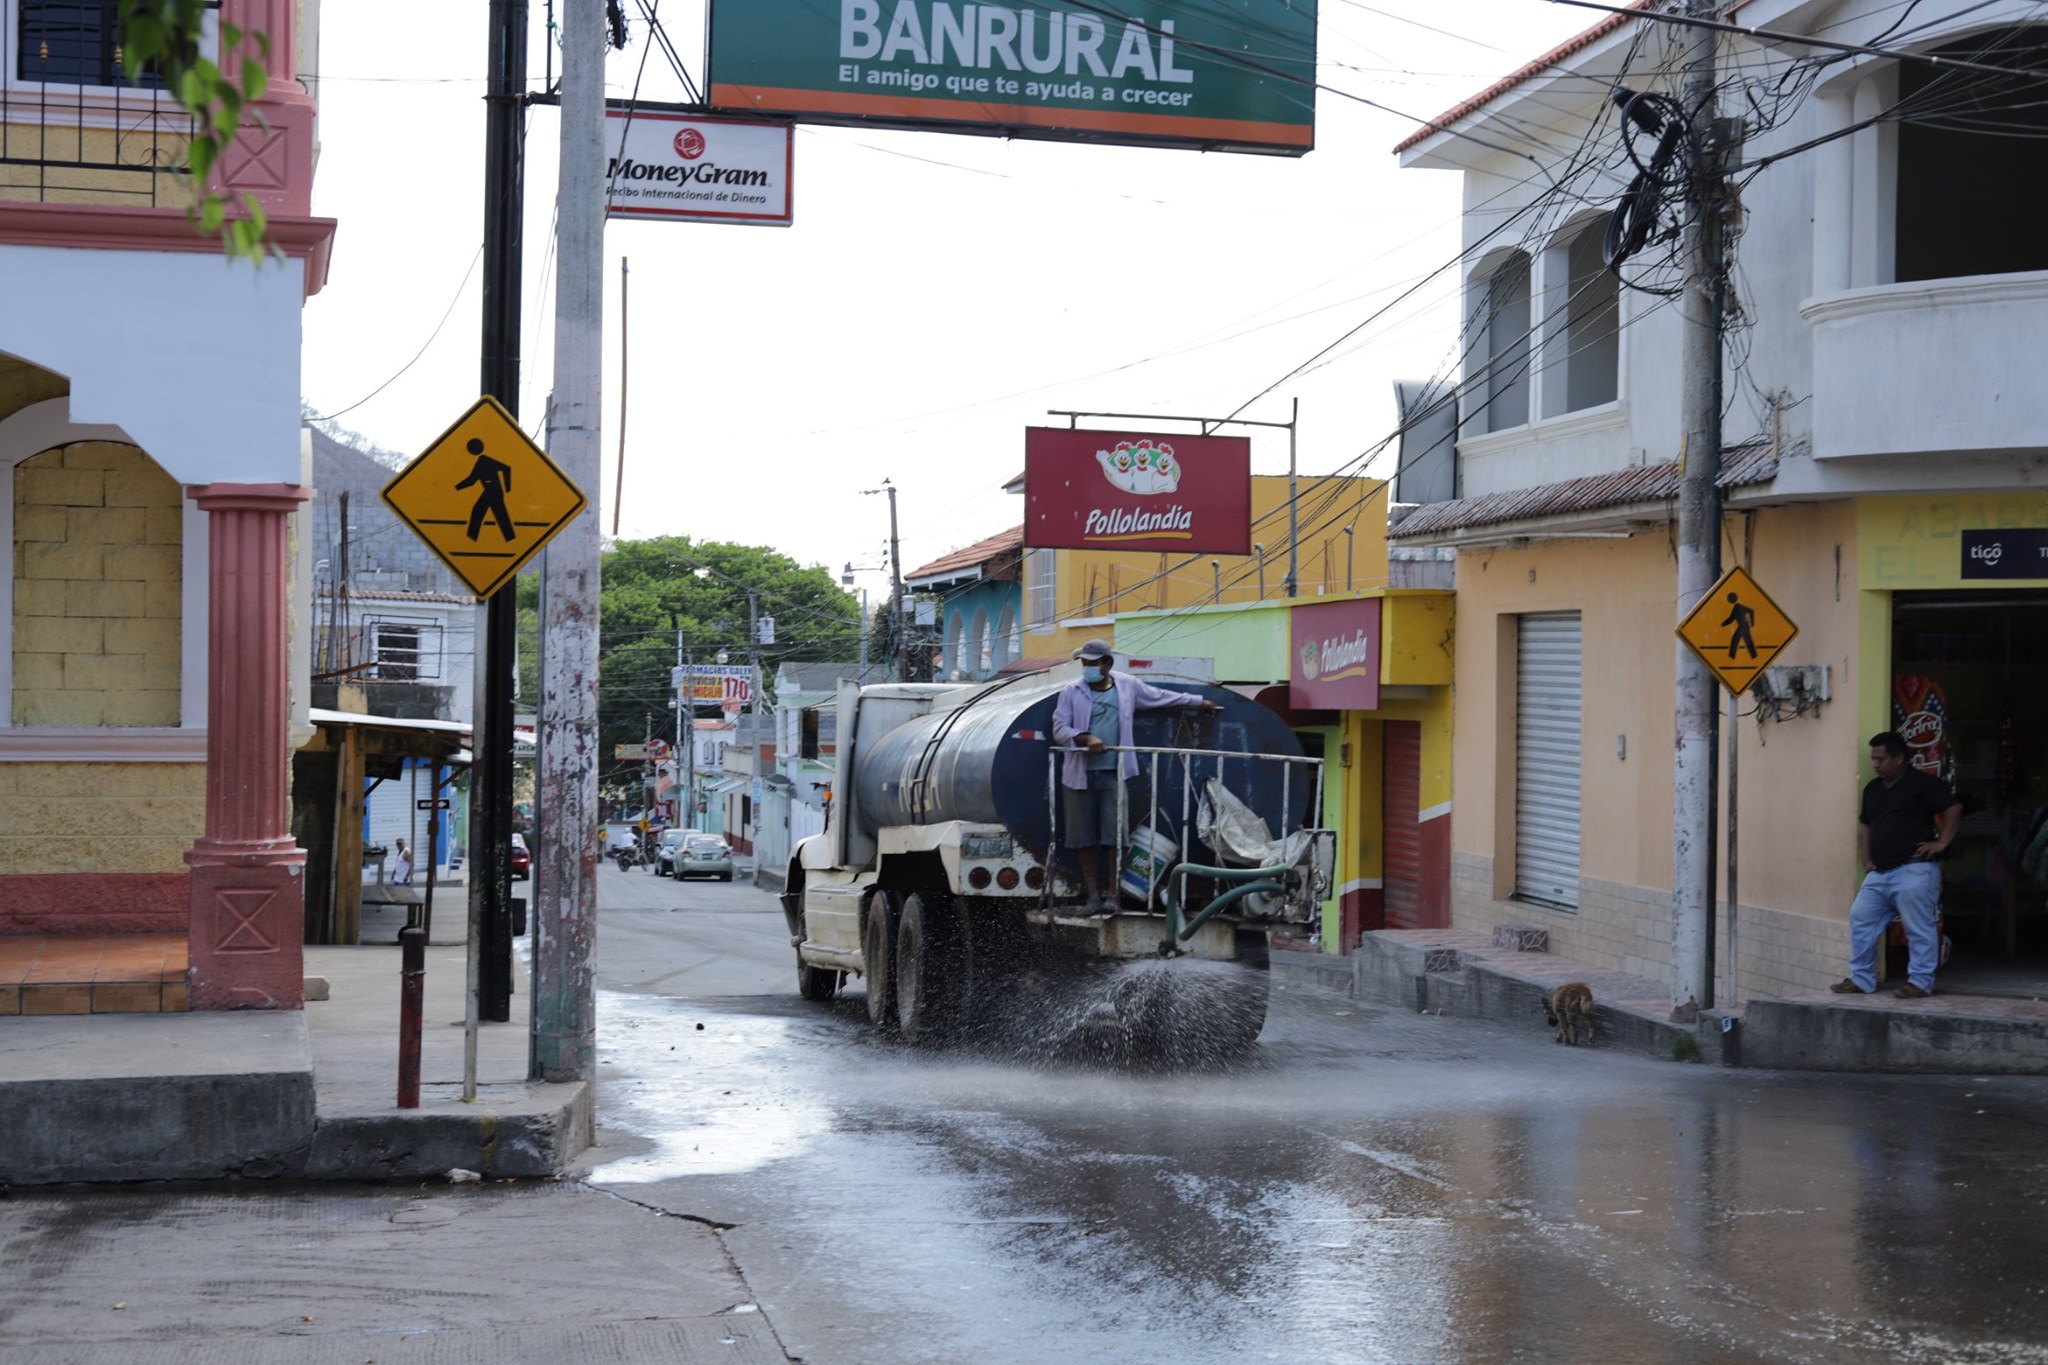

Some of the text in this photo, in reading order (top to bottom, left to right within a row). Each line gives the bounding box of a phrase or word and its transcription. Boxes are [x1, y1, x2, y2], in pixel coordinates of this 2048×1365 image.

[839, 0, 1194, 83] BANRURAL
[839, 64, 1193, 107] El amigo que te ayuda a crecer
[606, 157, 768, 187] MoneyGram
[642, 188, 713, 201] Internacional
[715, 191, 729, 202] de
[731, 192, 766, 204] Dinero
[1084, 504, 1193, 535] Pollolandia
[1970, 543, 2002, 566] tigo
[1321, 628, 1368, 673] Pollolandia
[682, 686, 723, 698] DMICILIO
[724, 677, 753, 700] 170
